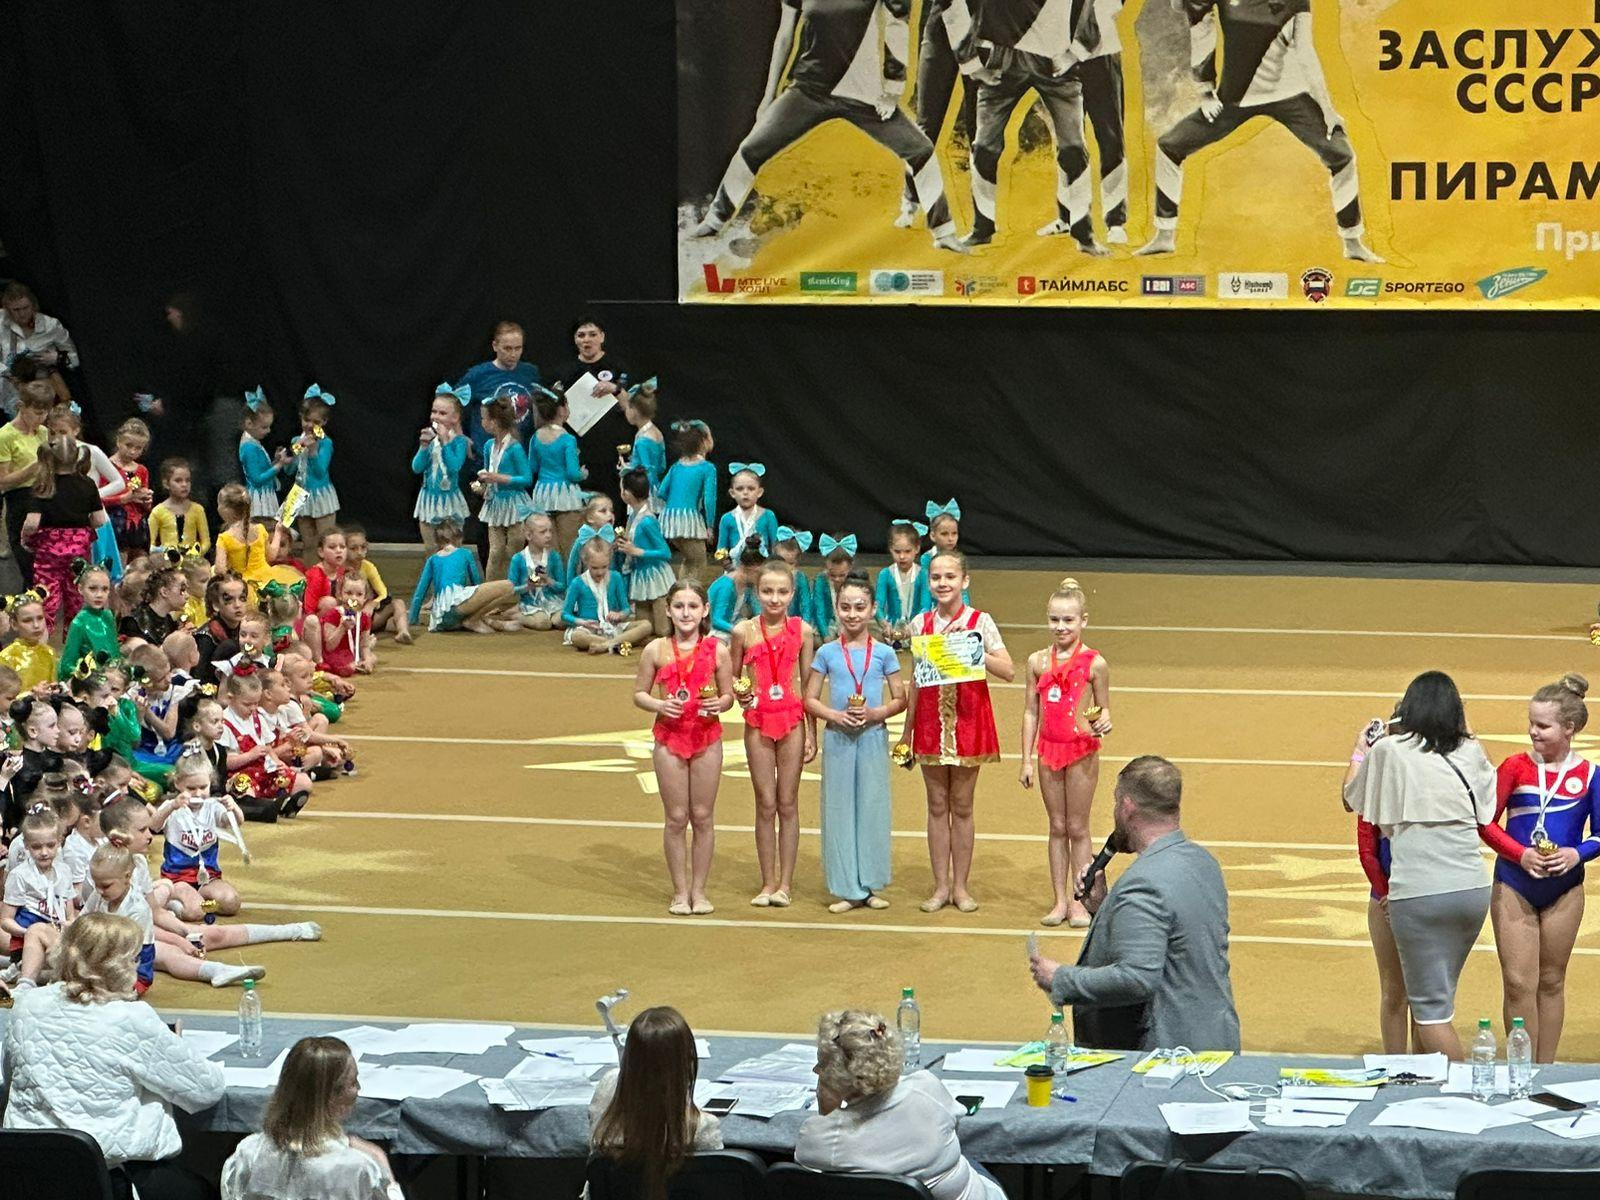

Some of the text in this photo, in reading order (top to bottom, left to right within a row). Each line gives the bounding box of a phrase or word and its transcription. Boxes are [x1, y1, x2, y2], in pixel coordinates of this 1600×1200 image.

[1456, 73, 1600, 113] СССР
[1039, 276, 1128, 292] ТАЙМЛАБС
[1385, 282, 1465, 293] SPORTEGO
